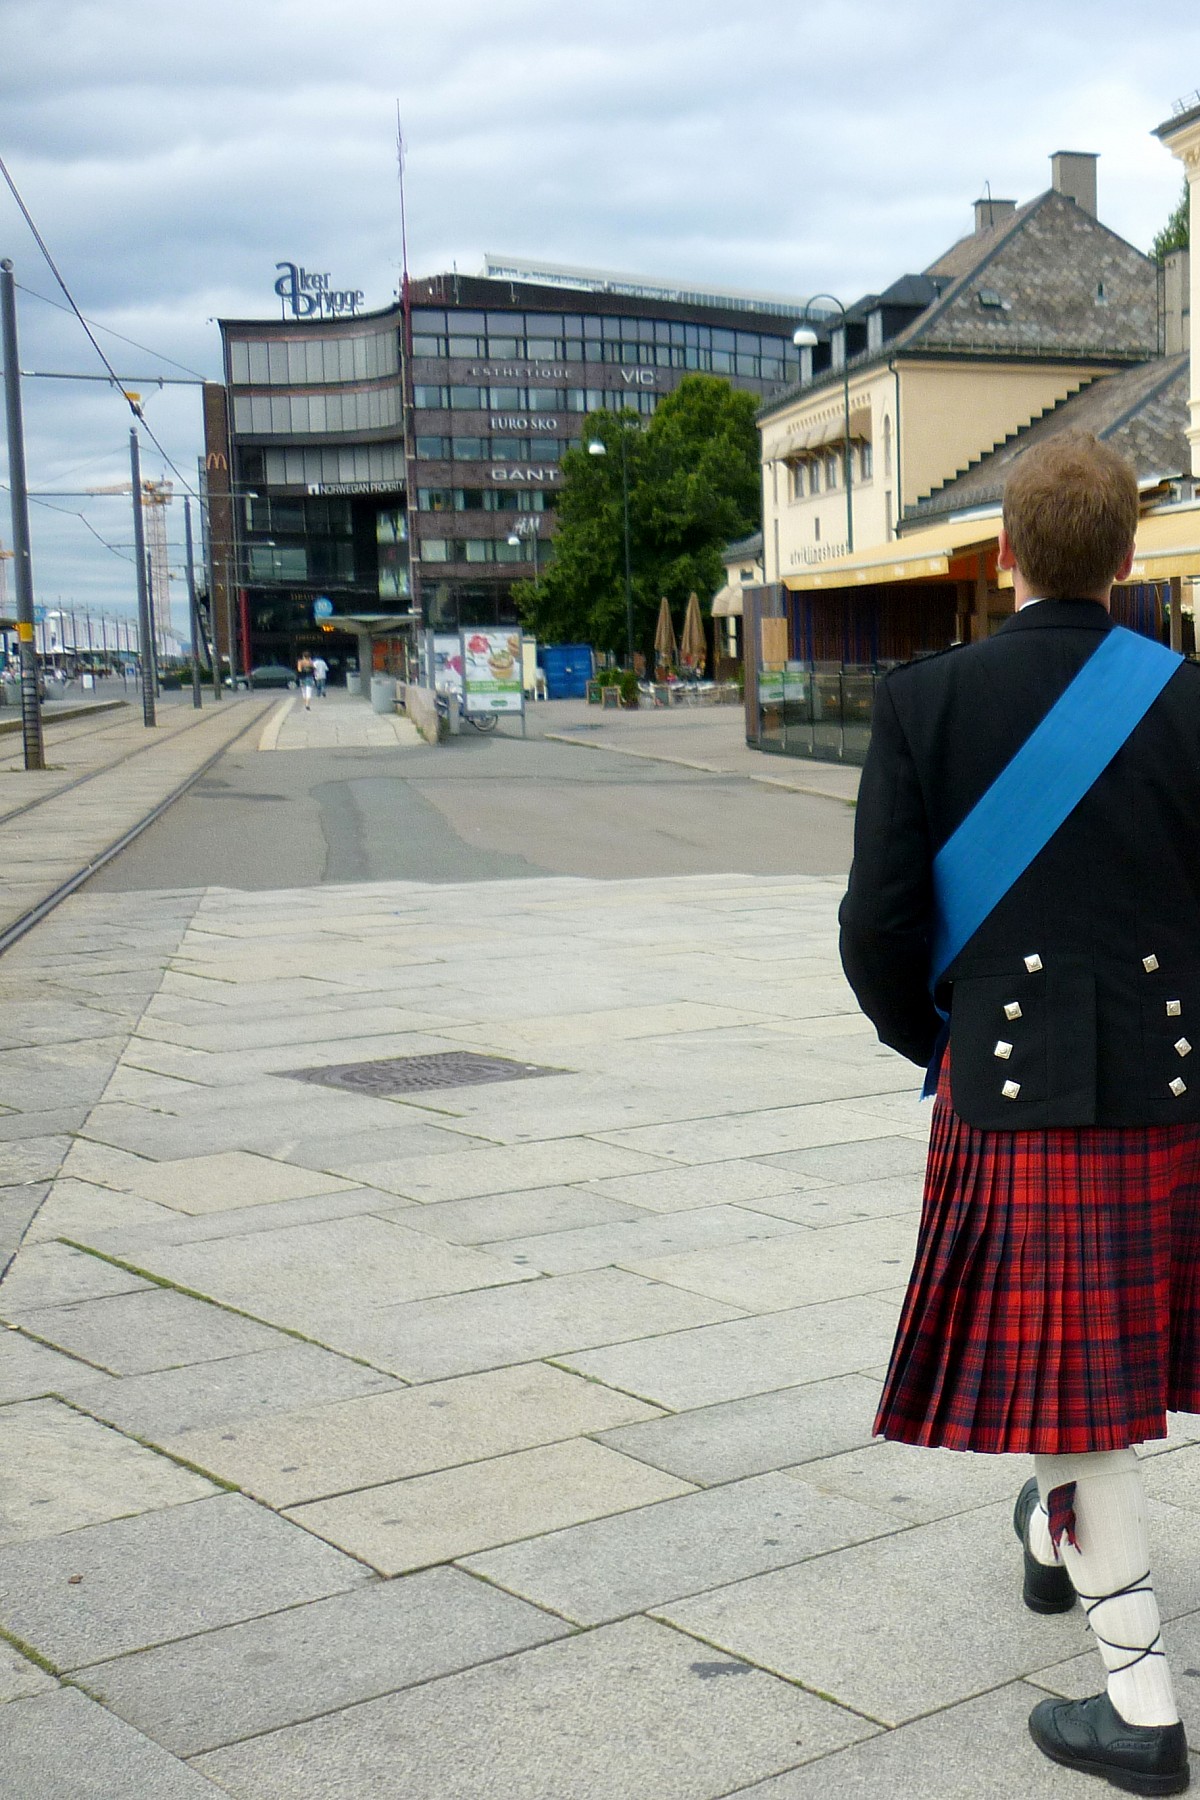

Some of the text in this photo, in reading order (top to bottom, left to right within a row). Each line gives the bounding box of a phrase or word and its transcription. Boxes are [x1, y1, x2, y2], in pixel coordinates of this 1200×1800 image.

[491, 417, 558, 430] EURO SKO
[491, 468, 558, 482] GANT
[320, 480, 404, 495] NORWEGIAN PROPERTY
